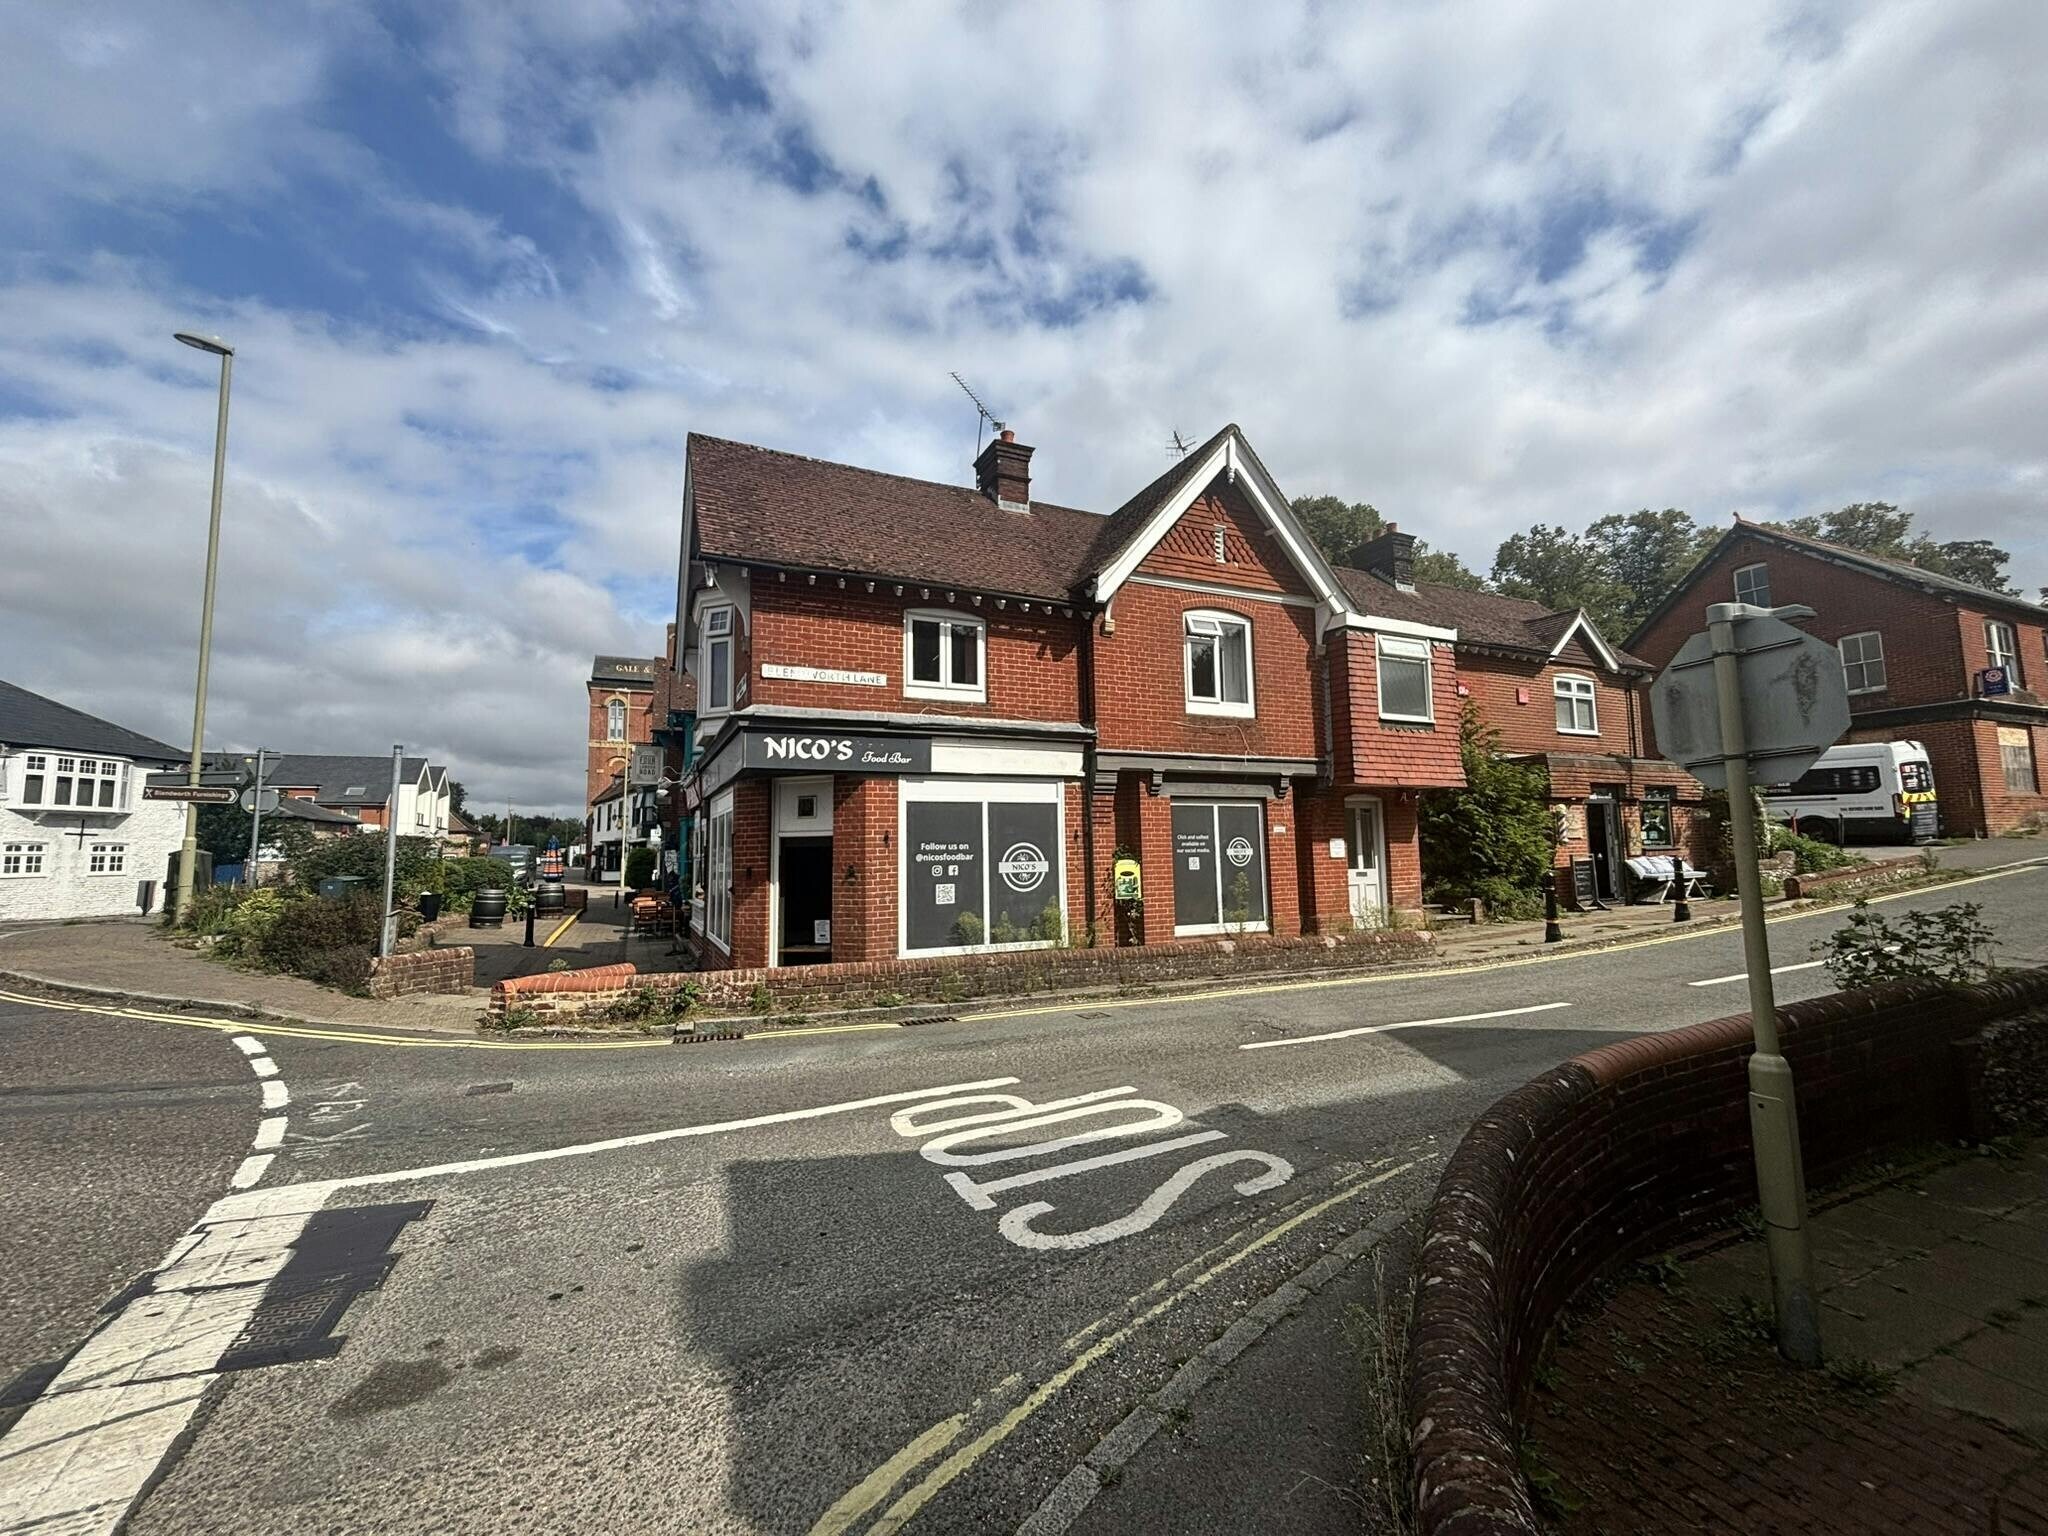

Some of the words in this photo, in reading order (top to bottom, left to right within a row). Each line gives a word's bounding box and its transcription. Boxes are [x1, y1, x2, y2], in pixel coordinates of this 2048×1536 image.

[615, 664, 640, 673] GALE
[767, 666, 850, 683] BLENWORTH
[853, 673, 881, 685] LANE
[763, 736, 853, 761] NICO'S
[861, 751, 887, 763] Food
[888, 752, 912, 764] Bar
[920, 842, 946, 850] Follow
[915, 852, 974, 862] @nicosfoodbar
[1011, 863, 1037, 871] NICO'S
[890, 1085, 1295, 1251] STOP
